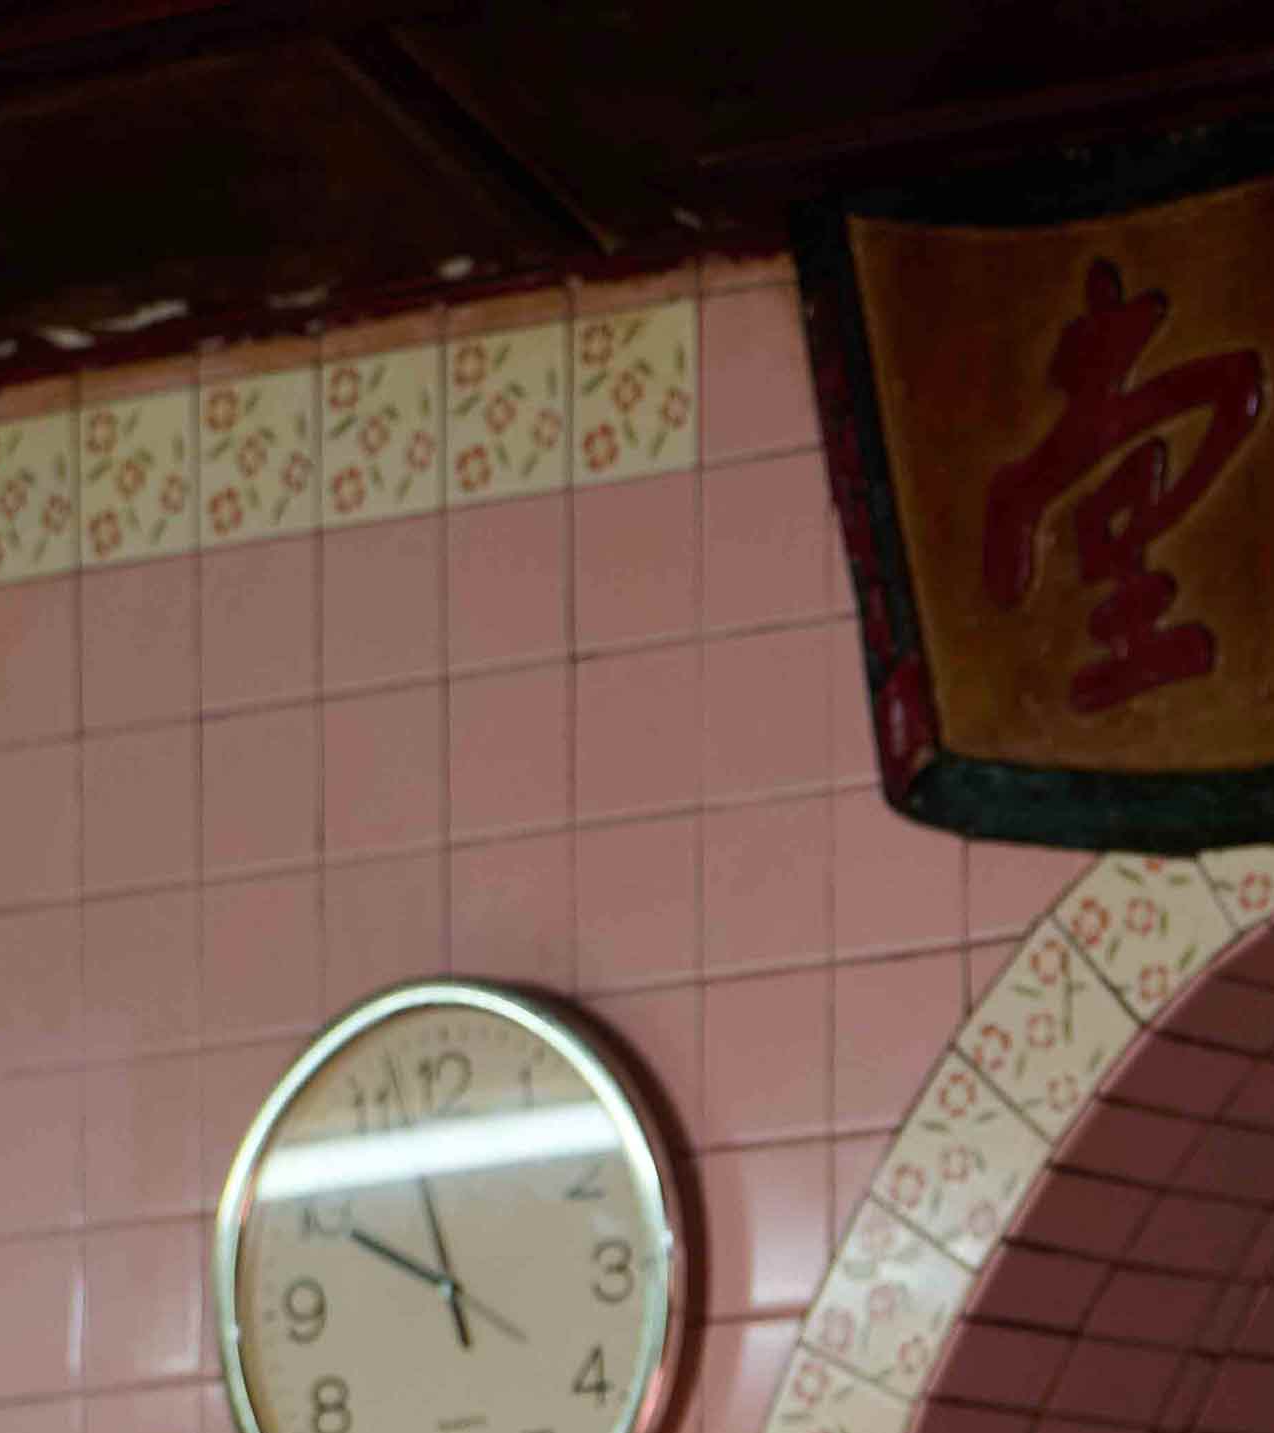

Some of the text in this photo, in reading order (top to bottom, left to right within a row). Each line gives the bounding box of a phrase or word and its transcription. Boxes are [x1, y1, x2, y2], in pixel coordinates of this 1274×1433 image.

[417, 1052, 474, 1112] 12
[592, 1239, 635, 1303] 3
[283, 1278, 327, 1344] 9
[573, 1345, 613, 1404] 4
